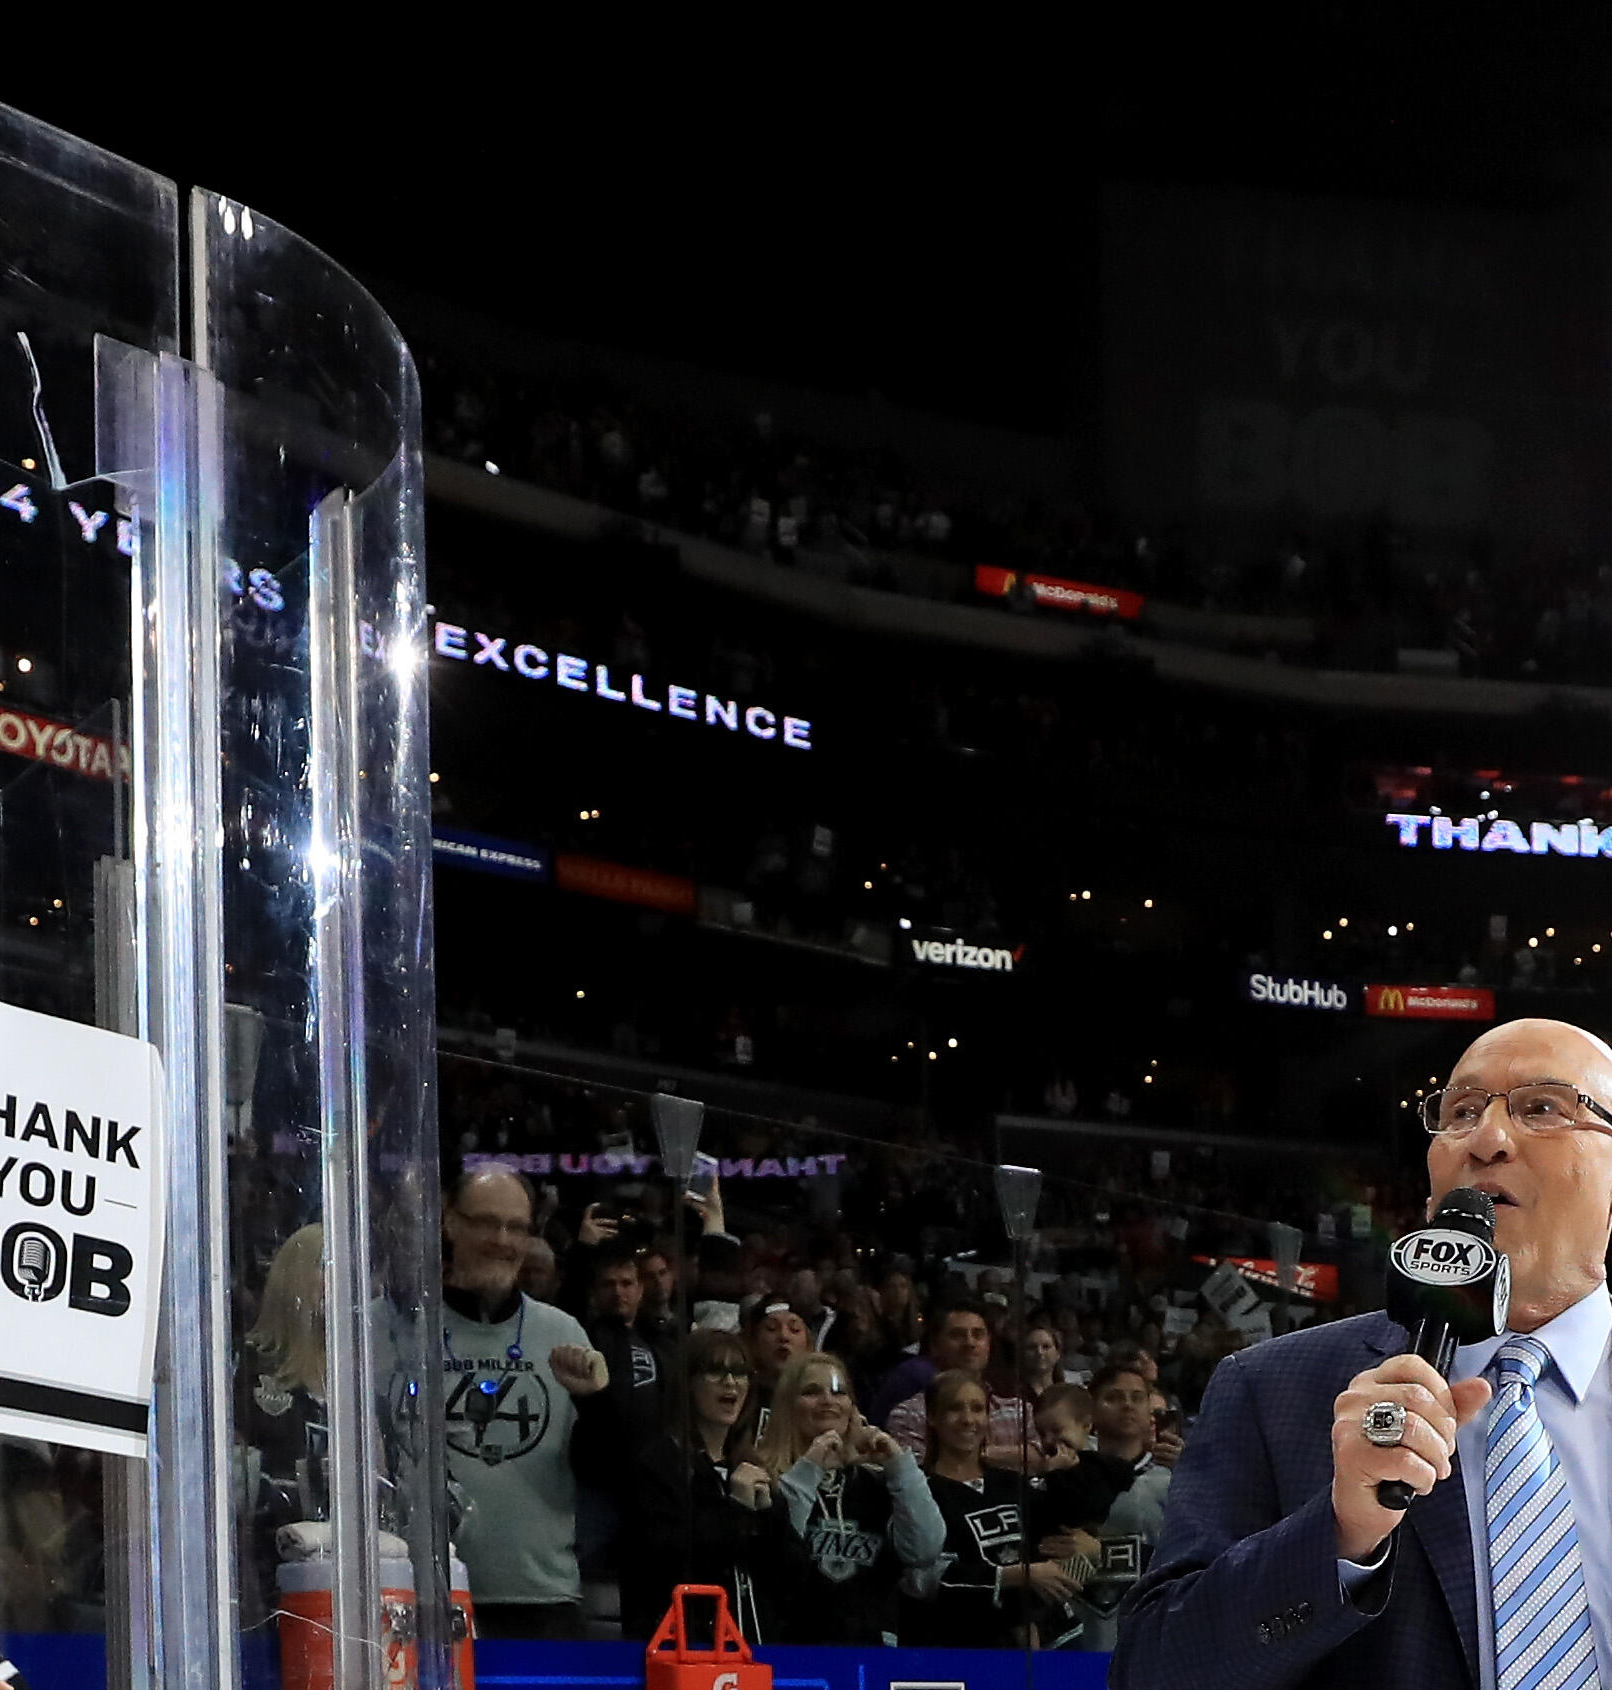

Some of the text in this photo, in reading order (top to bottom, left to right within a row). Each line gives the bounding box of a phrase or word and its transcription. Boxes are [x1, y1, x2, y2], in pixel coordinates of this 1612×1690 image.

[434, 620, 812, 749] EXCELLENCE
[911, 939, 1014, 972] verizon
[1250, 973, 1348, 1010] StubHub
[1413, 1238, 1476, 1267] FOX
[1410, 1260, 1472, 1277] SPORTS
[478, 1358, 536, 1373] MILLER
